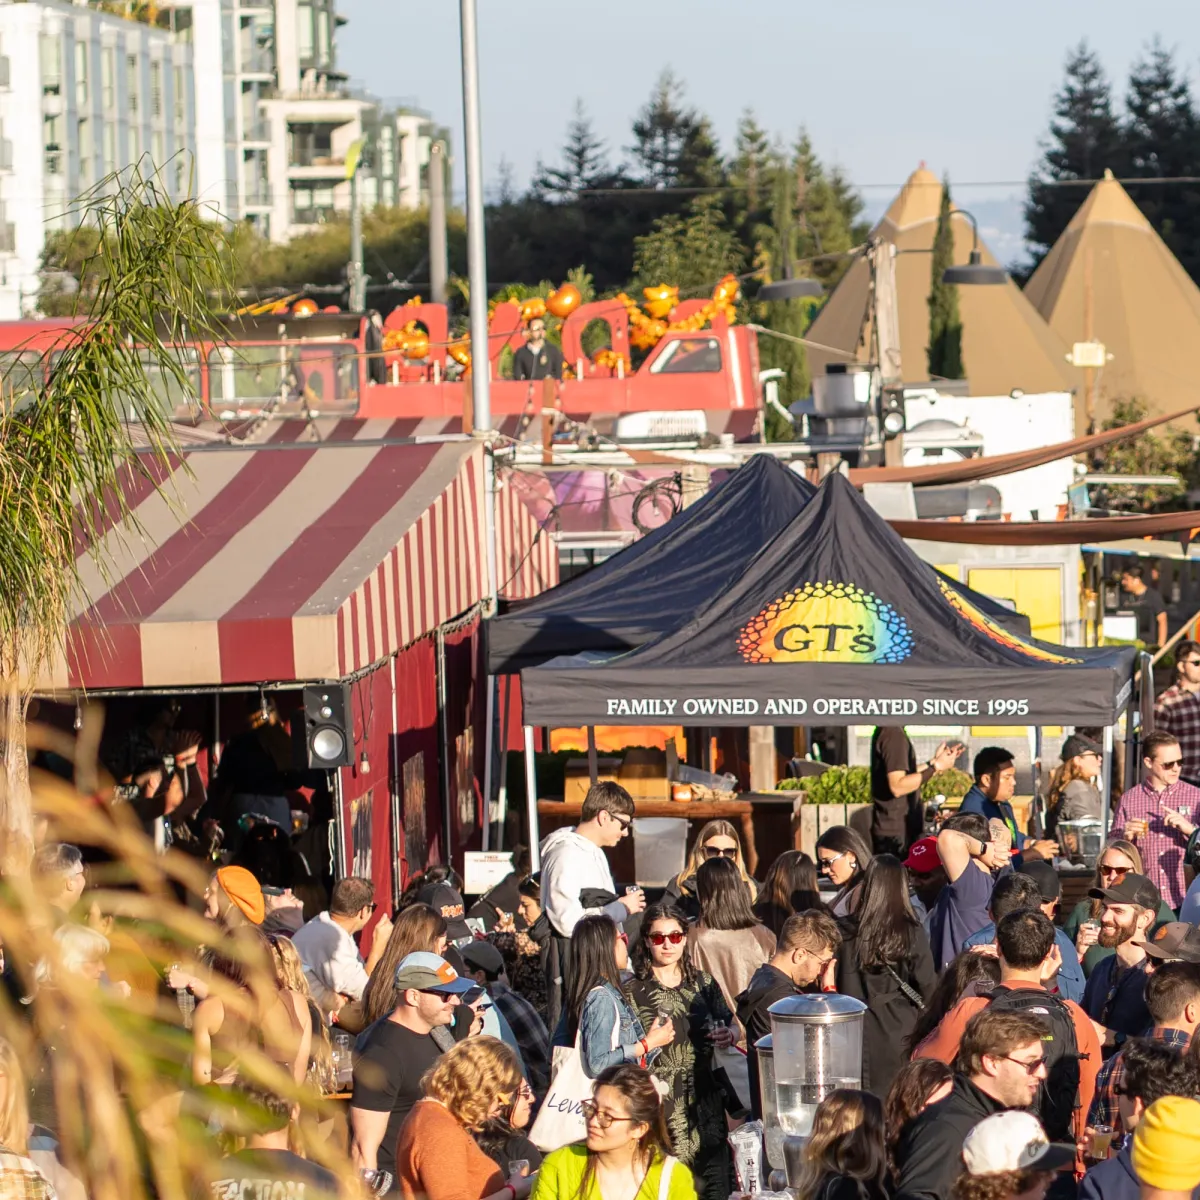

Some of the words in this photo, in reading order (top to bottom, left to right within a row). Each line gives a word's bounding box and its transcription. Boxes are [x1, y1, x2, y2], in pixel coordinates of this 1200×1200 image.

[773, 623, 877, 653] GT's
[607, 698, 677, 715] FAMILY
[683, 698, 758, 715] OWNED
[764, 698, 807, 715] AND
[813, 698, 917, 715] OPERATED
[923, 698, 979, 715] SINCE
[987, 698, 1029, 715] 1995
